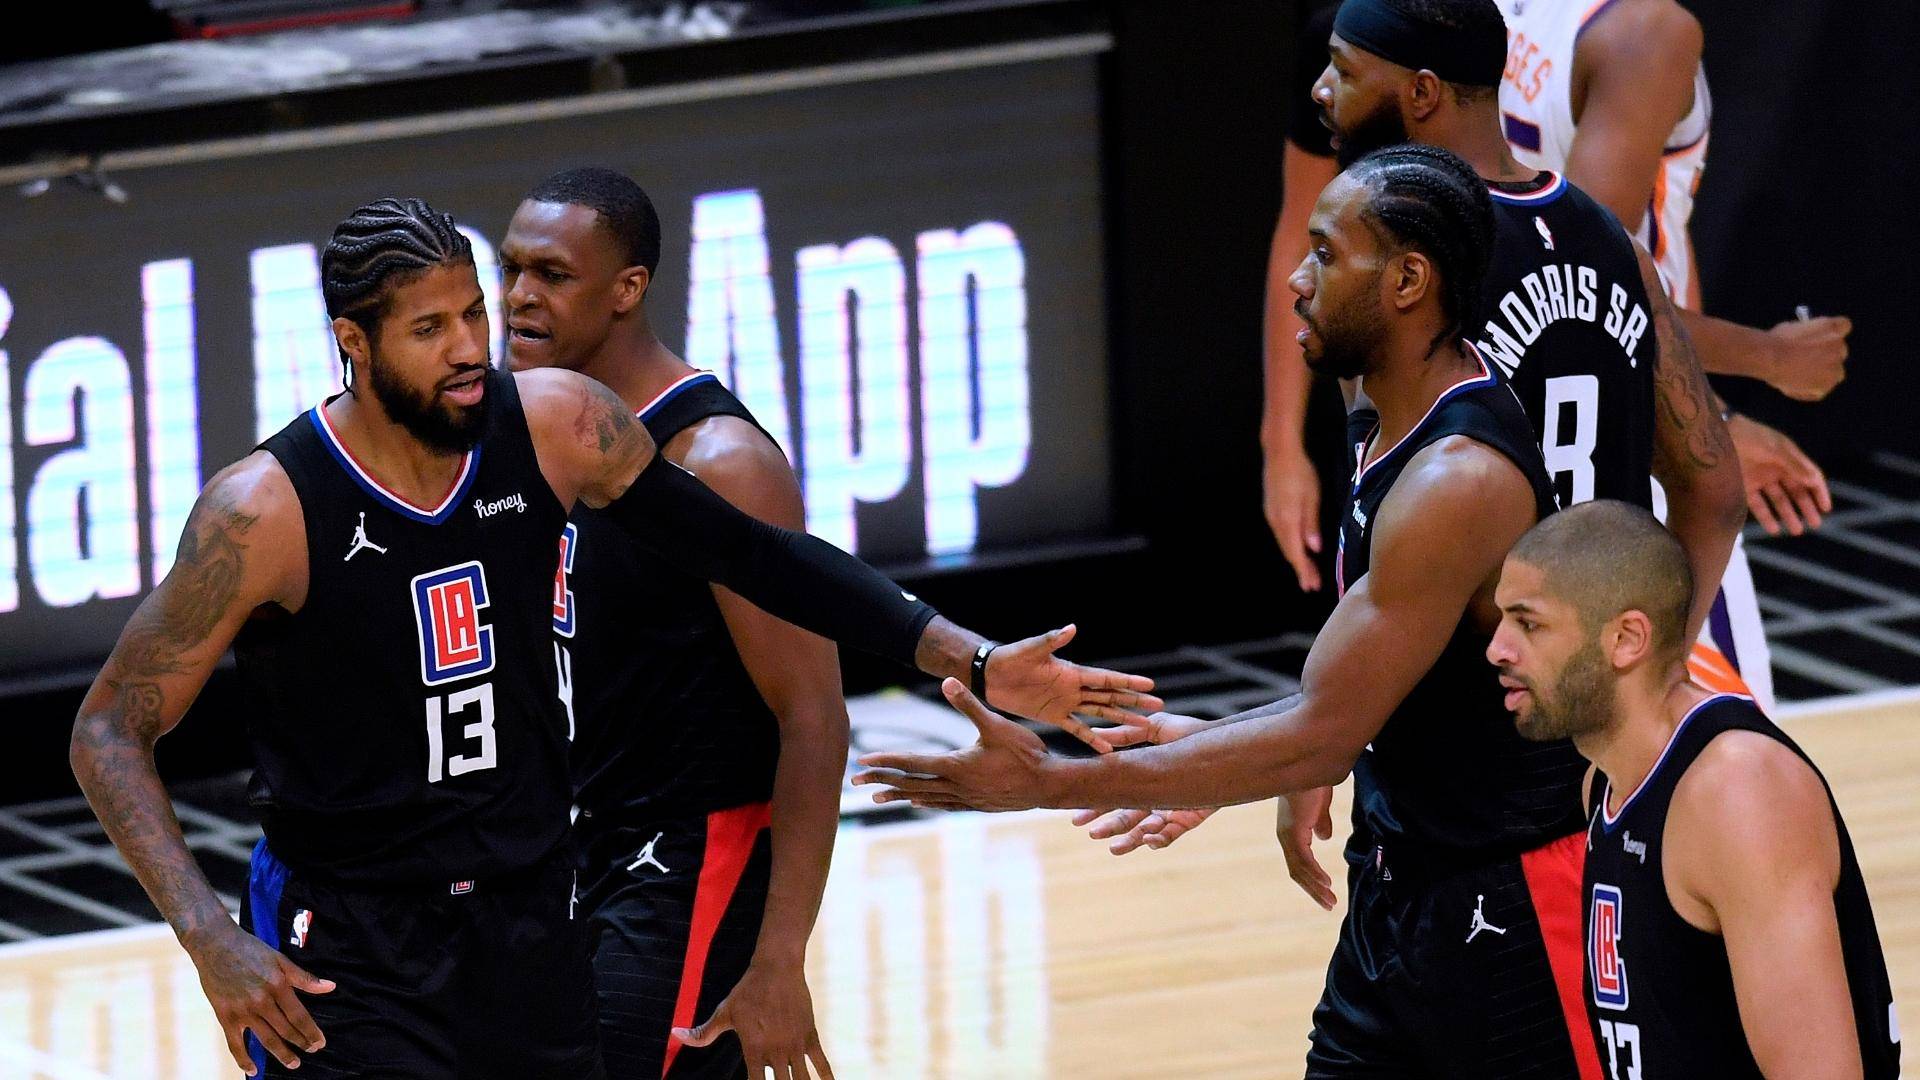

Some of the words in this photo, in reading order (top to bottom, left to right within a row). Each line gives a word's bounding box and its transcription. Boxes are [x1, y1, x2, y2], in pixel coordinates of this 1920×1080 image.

[1503, 28, 1553, 104] GES
[683, 188, 1032, 557] App
[1476, 263, 1598, 380] MORRIS
[1603, 282, 1648, 369] SR.
[1542, 374, 1599, 505] 8
[473, 492, 528, 519] honey
[425, 682, 497, 784] 13
